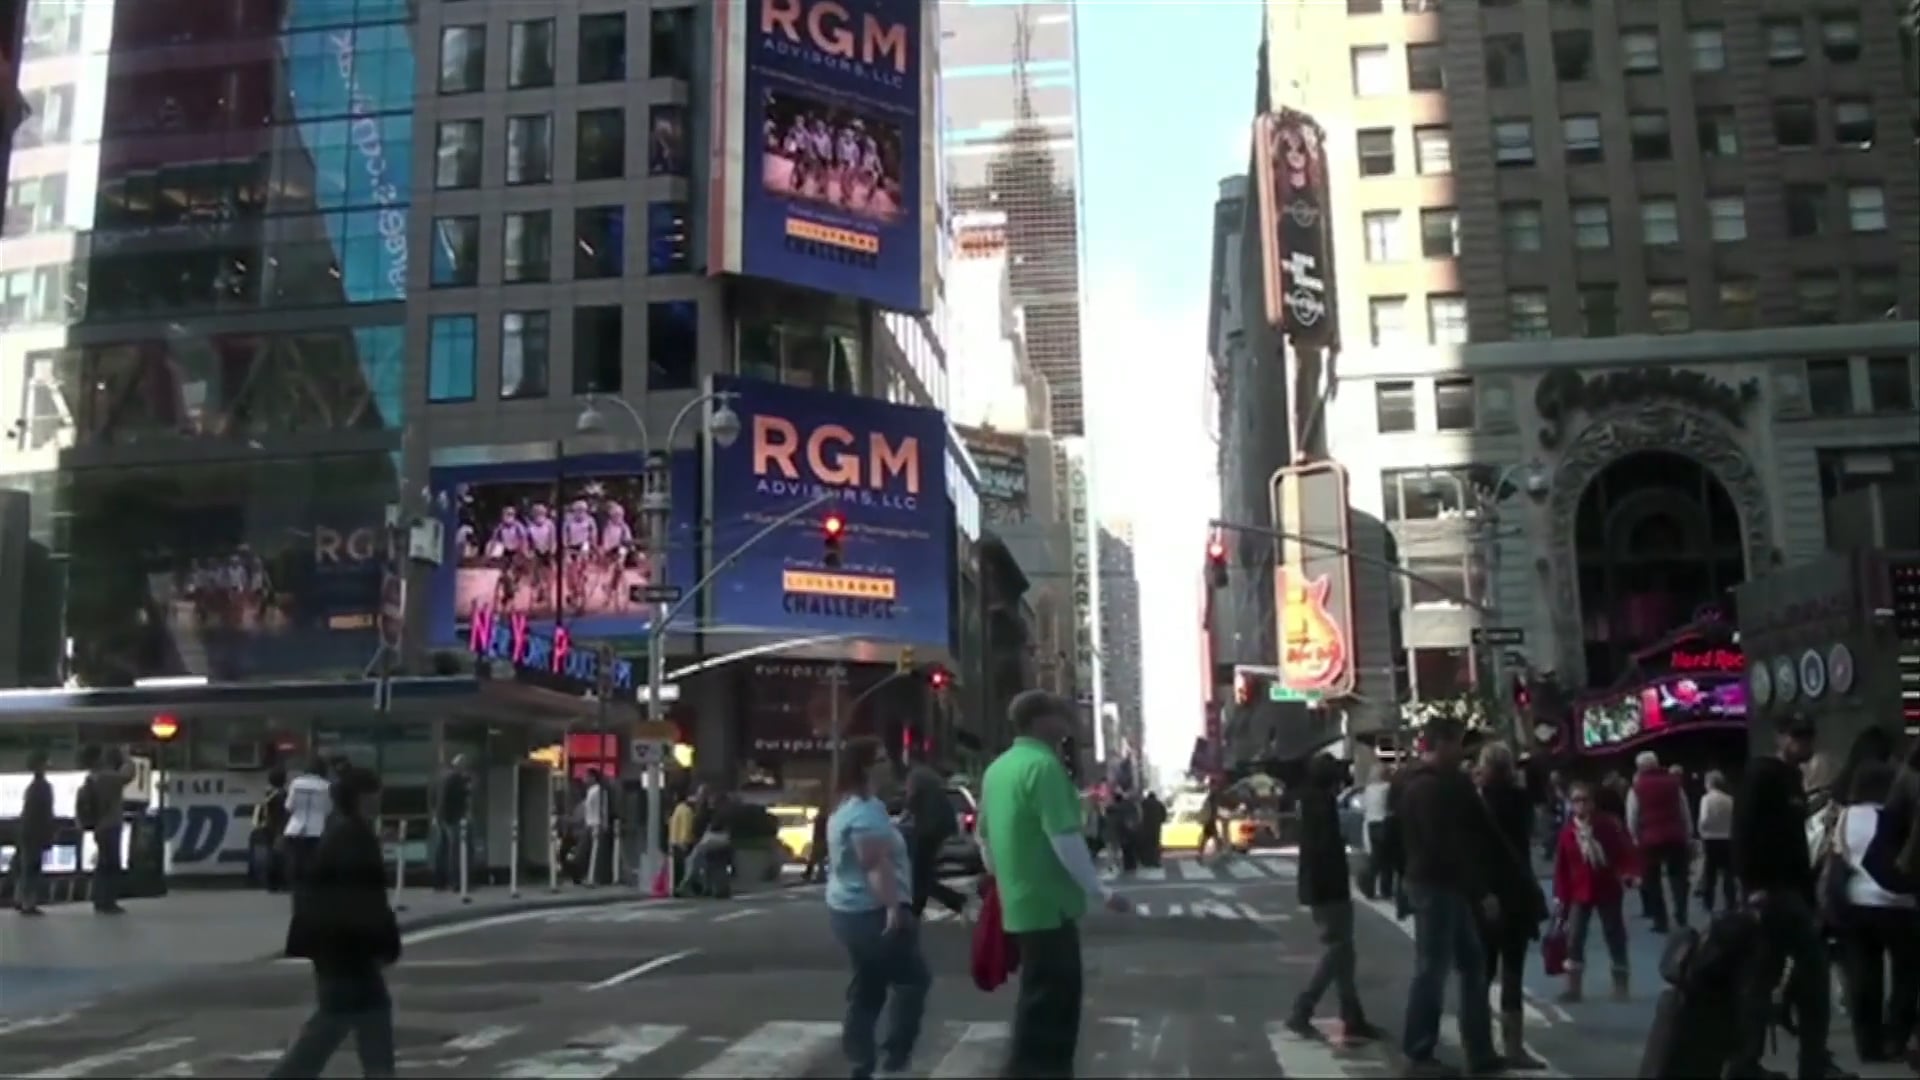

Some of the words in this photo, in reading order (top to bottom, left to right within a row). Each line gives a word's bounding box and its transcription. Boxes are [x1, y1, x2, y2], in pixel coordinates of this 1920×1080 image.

[760, 0, 907, 74] RGM
[753, 413, 920, 493] RGM
[881, 493, 918, 511] LLC
